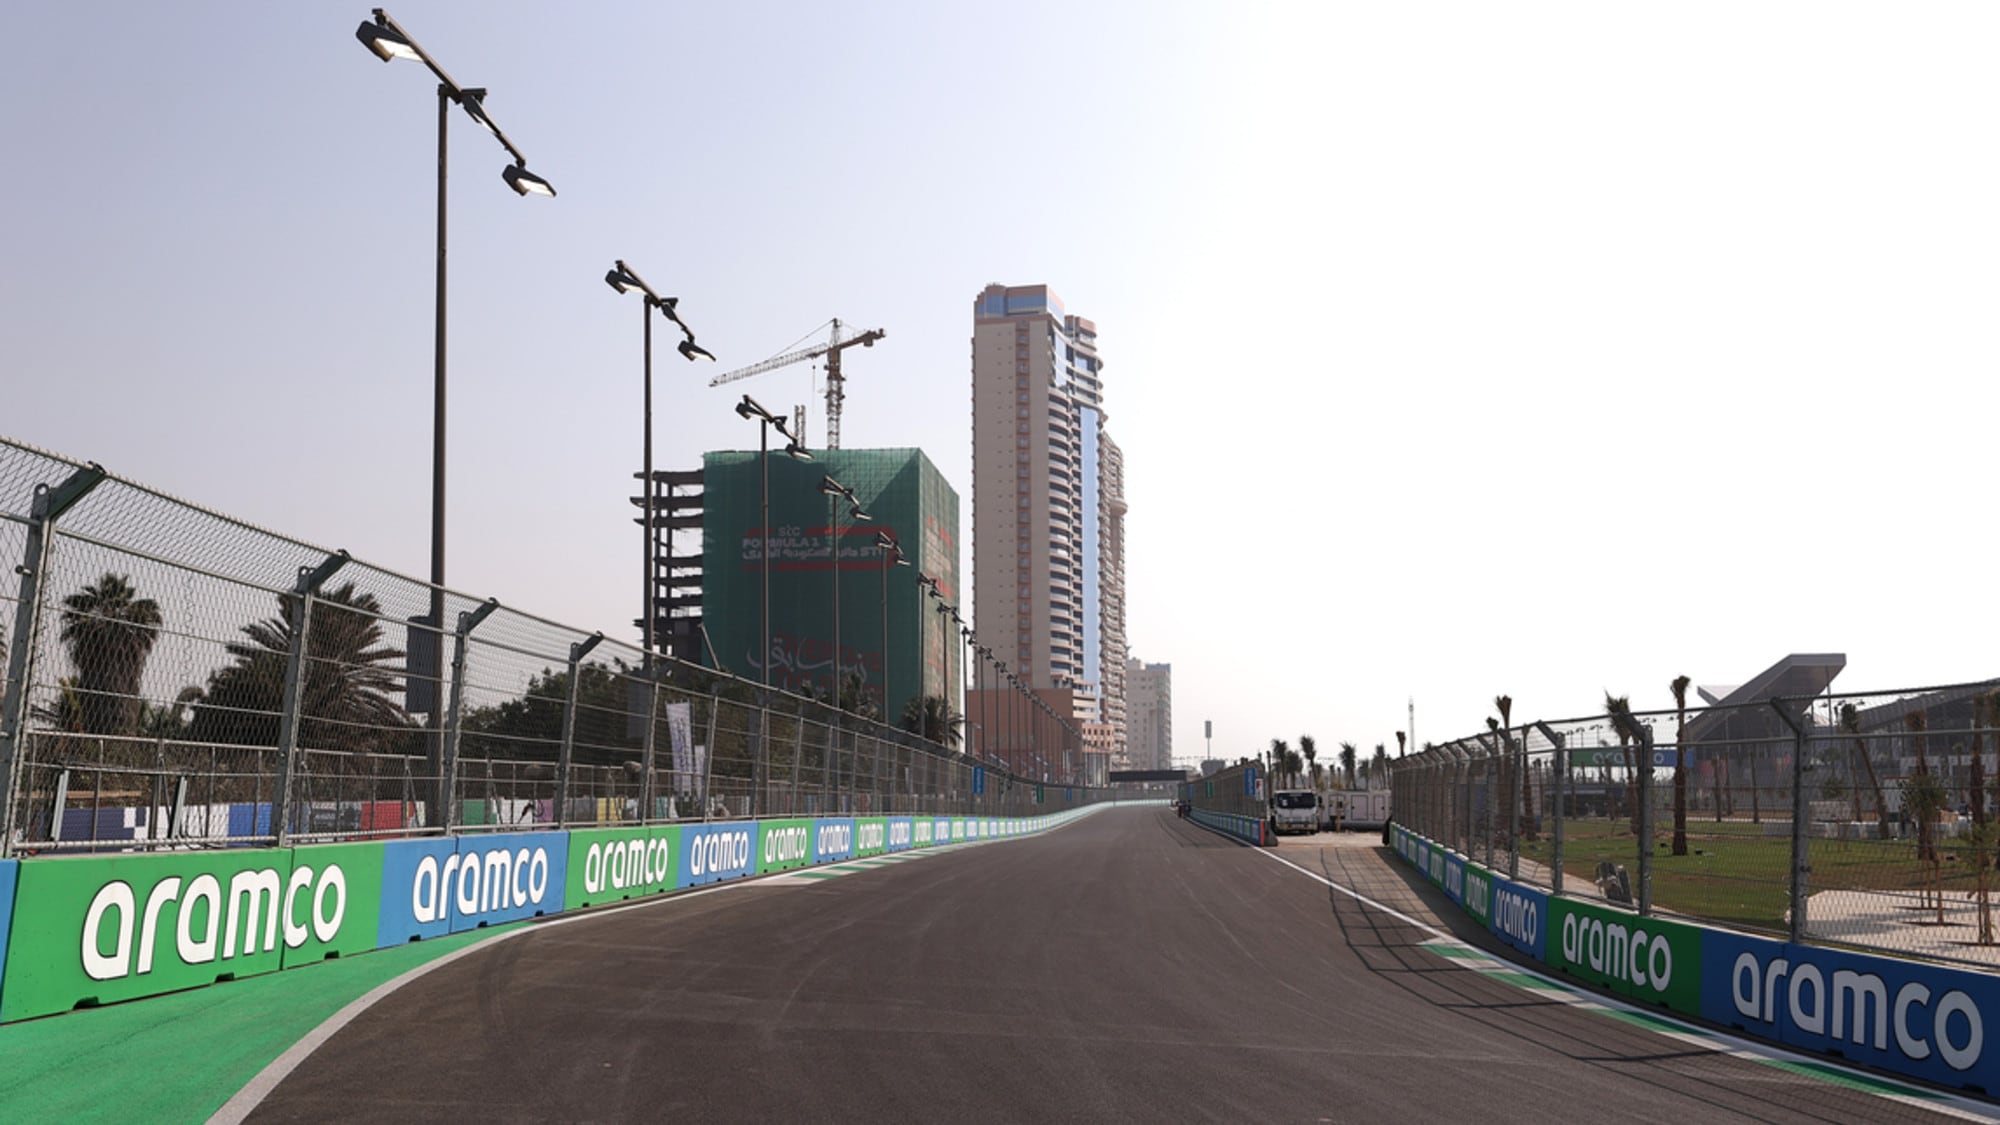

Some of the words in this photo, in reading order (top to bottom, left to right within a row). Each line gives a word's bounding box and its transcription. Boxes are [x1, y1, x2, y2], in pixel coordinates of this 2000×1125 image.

[583, 837, 669, 894] aramco
[690, 831, 749, 876] aramco
[764, 826, 808, 864] aramco
[817, 824, 851, 856] aramco
[411, 846, 548, 924] aramco
[81, 864, 347, 981] aramco
[1495, 887, 1537, 948] aramco
[1562, 912, 1673, 992] aramco
[1732, 952, 1984, 1071] aramco
